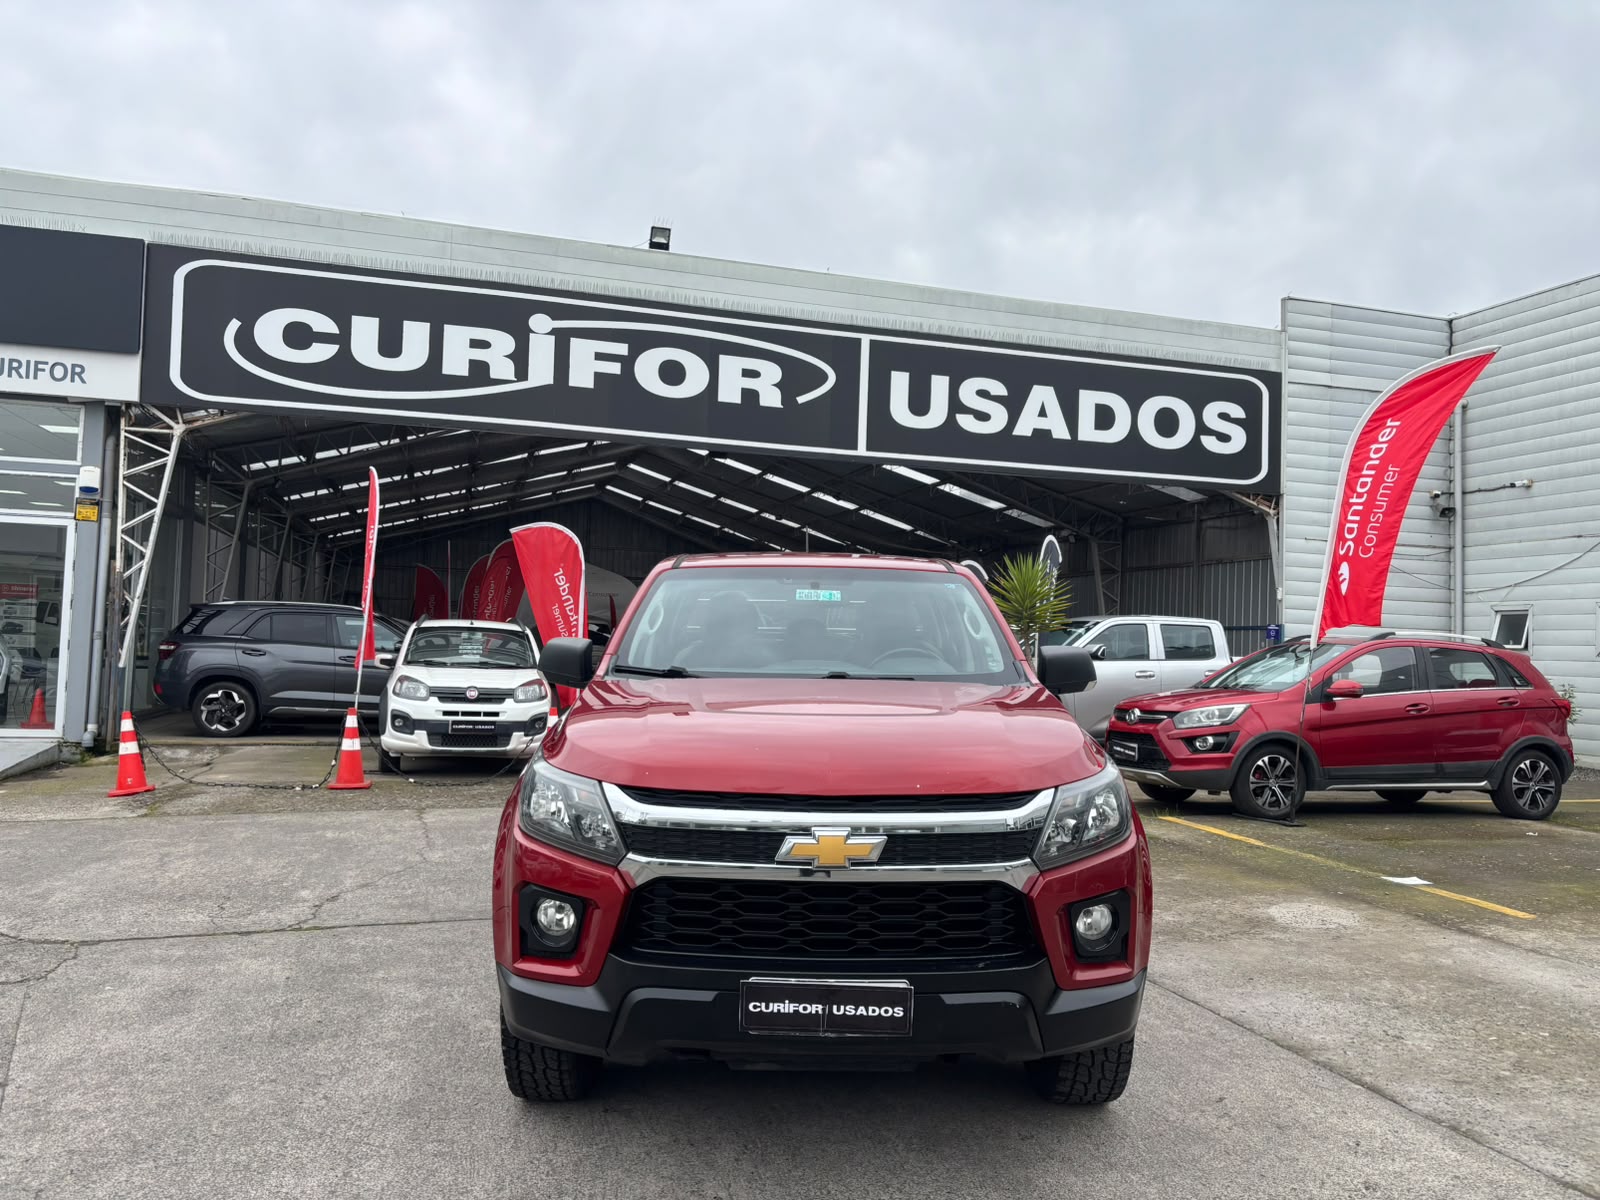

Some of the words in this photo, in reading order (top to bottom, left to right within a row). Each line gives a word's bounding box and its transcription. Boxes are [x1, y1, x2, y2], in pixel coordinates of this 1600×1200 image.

[889, 370, 1247, 455] USADOS
[1339, 418, 1400, 556] Santander
[1358, 464, 1400, 558] Consumer
[833, 1005, 904, 1017] USADOS
